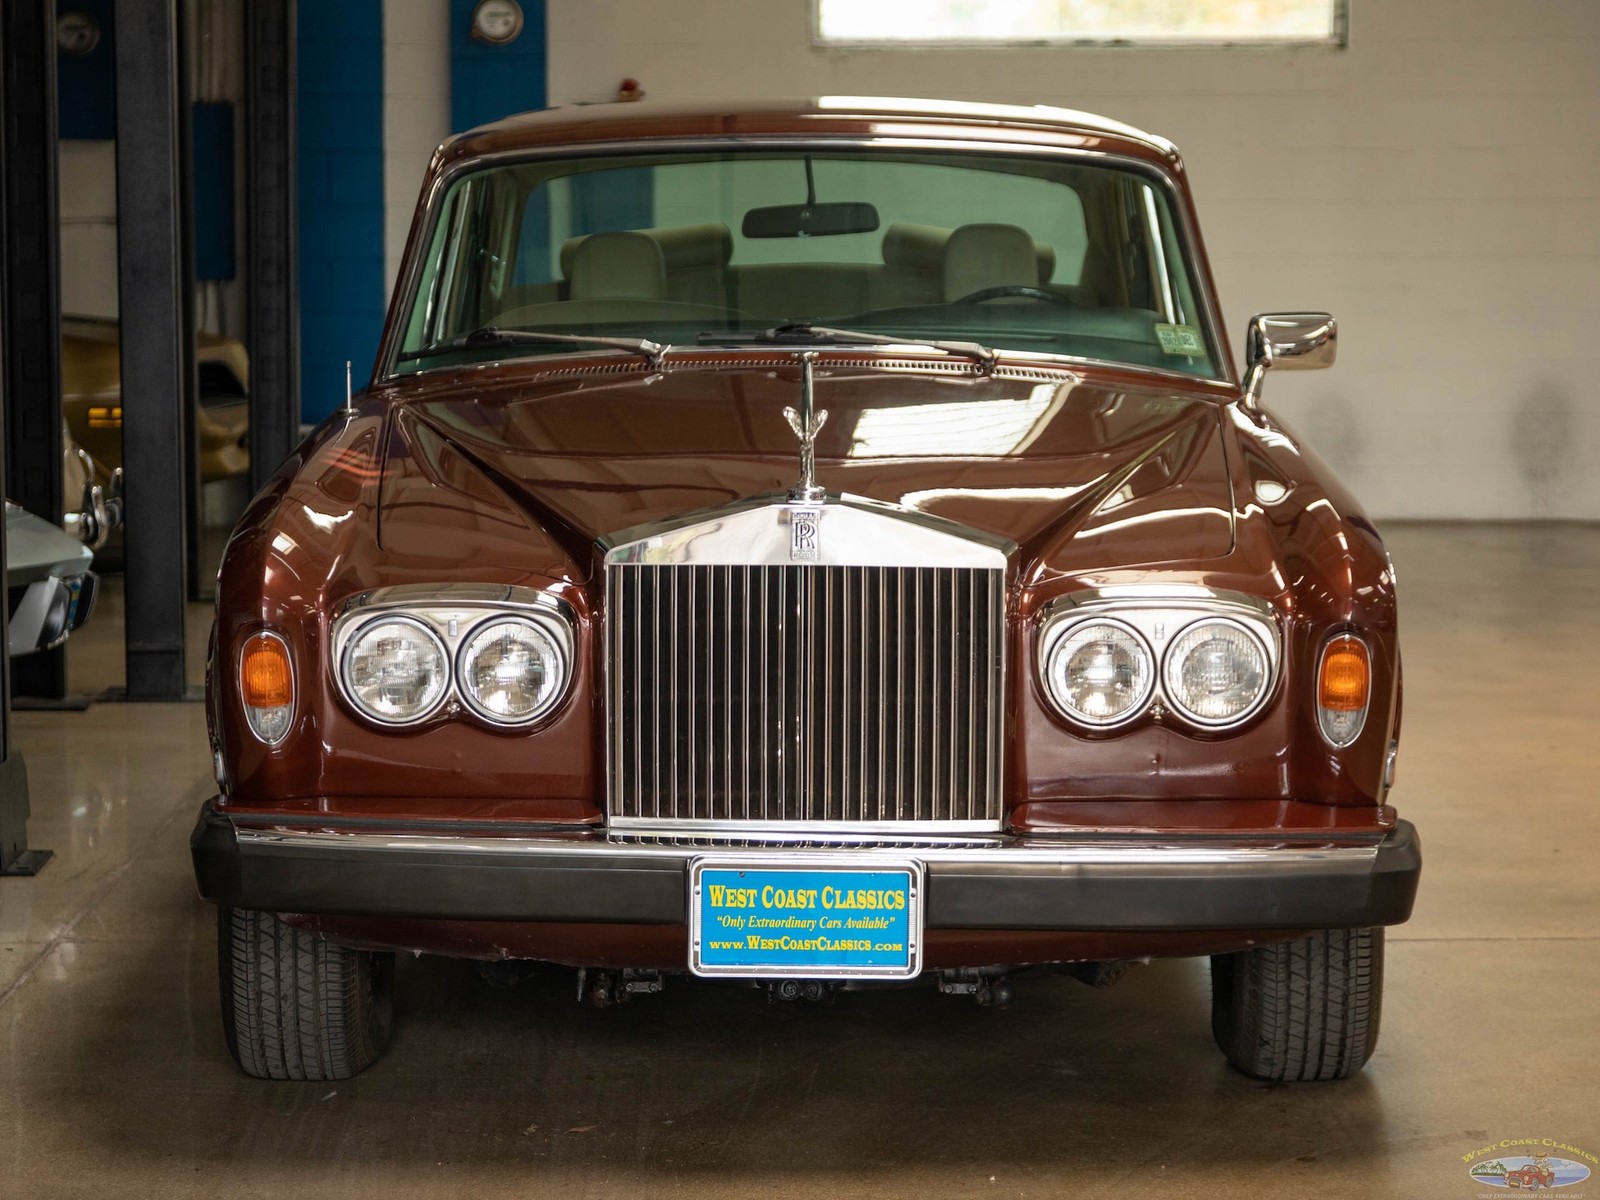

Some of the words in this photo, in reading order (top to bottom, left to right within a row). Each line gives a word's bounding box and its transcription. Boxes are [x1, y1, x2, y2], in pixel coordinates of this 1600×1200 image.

[708, 885, 758, 908] WEST
[762, 885, 817, 909] COAST
[821, 886, 905, 910] CLASSICS
[748, 915, 817, 932] Extraordinary
[819, 916, 842, 930] Cars
